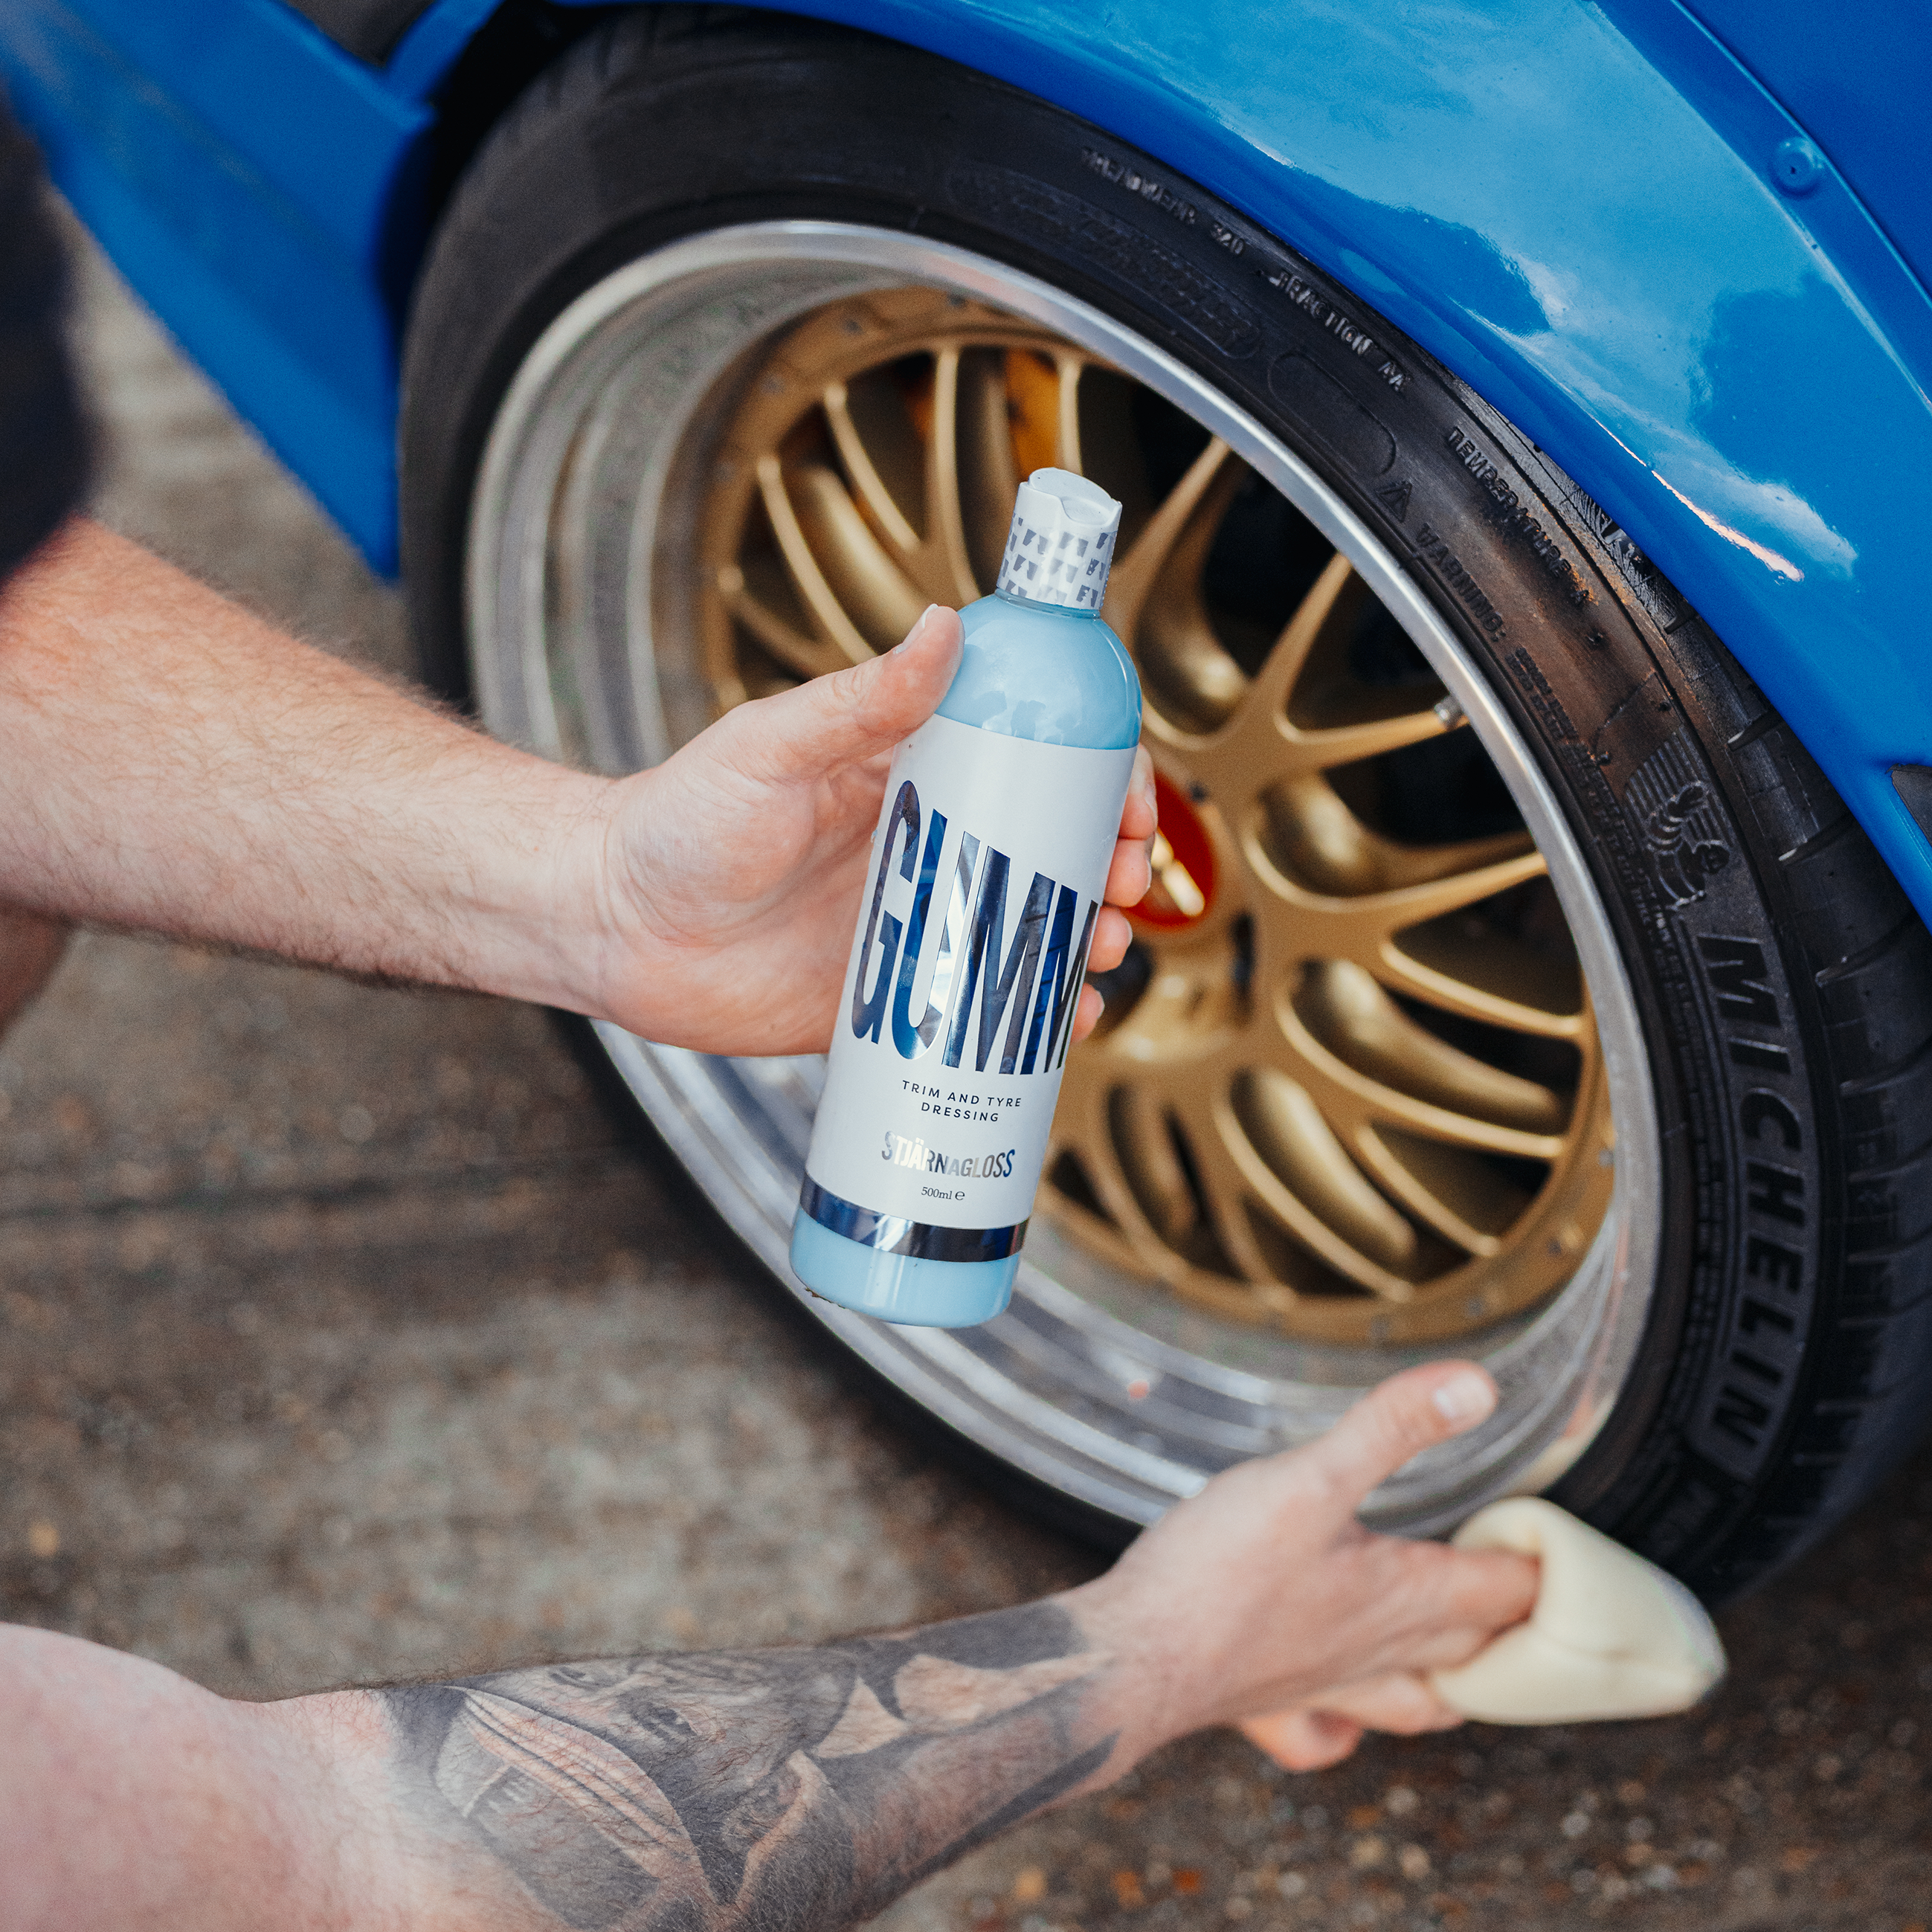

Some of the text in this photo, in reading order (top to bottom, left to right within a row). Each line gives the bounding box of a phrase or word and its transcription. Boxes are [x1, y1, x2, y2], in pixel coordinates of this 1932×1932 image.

[1448, 426, 1572, 577] TEMPERATURE
[902, 1080, 1022, 1107] TRIM AND TYRE
[921, 1102, 999, 1122] DRESSING
[881, 1130, 1016, 1178] STJÄRNAGLOSS
[921, 1186, 953, 1200] 500ml
[1696, 933, 1807, 1451] MICHELIN
